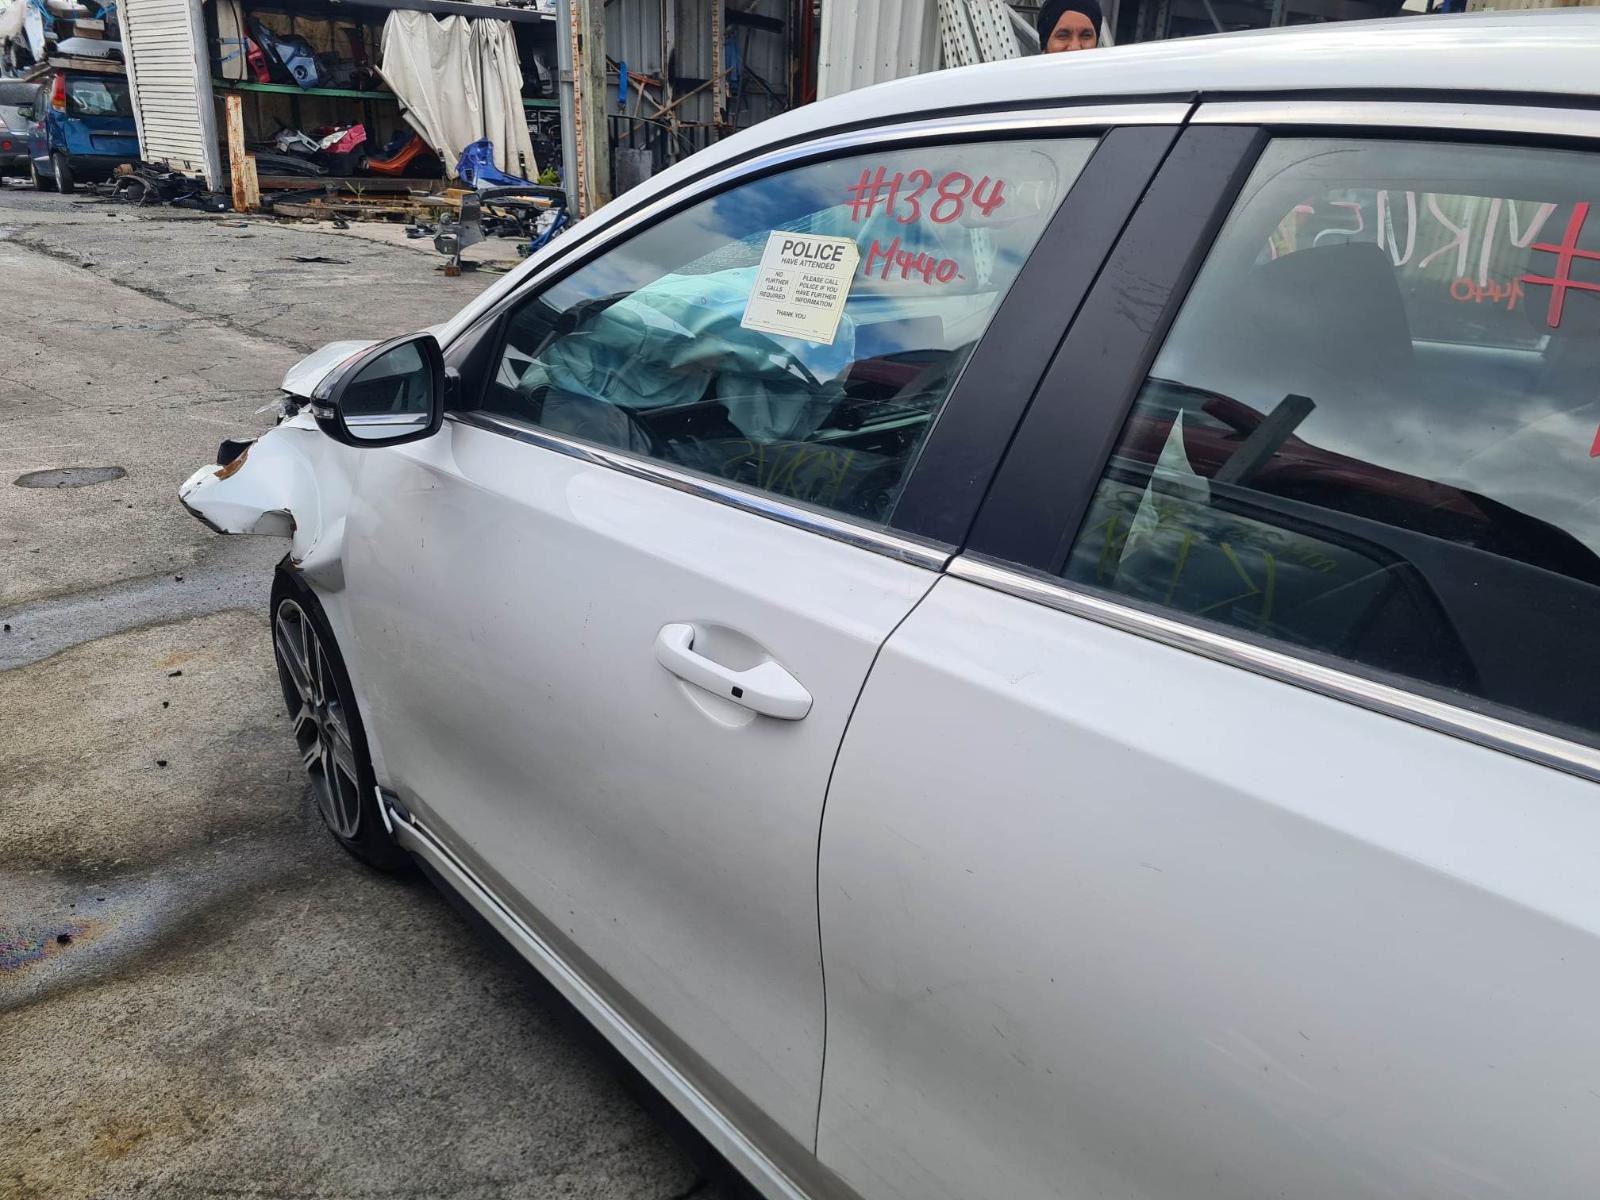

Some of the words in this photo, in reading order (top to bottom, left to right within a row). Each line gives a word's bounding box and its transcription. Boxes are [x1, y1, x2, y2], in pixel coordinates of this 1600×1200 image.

[847, 166, 1005, 224] #1384
[781, 240, 845, 262] POLICE
[781, 258, 798, 266] HAVE
[799, 260, 835, 270] ATTENDED
[765, 278, 789, 286] FURTHER
[802, 275, 824, 283] PLEASE
[824, 278, 839, 286] CALL
[799, 282, 820, 291] POLICE
[826, 285, 838, 293] YOU
[759, 291, 786, 300] REQUIRED
[810, 291, 837, 300] FURTHER
[795, 296, 833, 308] INFORMATION
[776, 309, 795, 318] THANK
[795, 312, 807, 320] YOU
